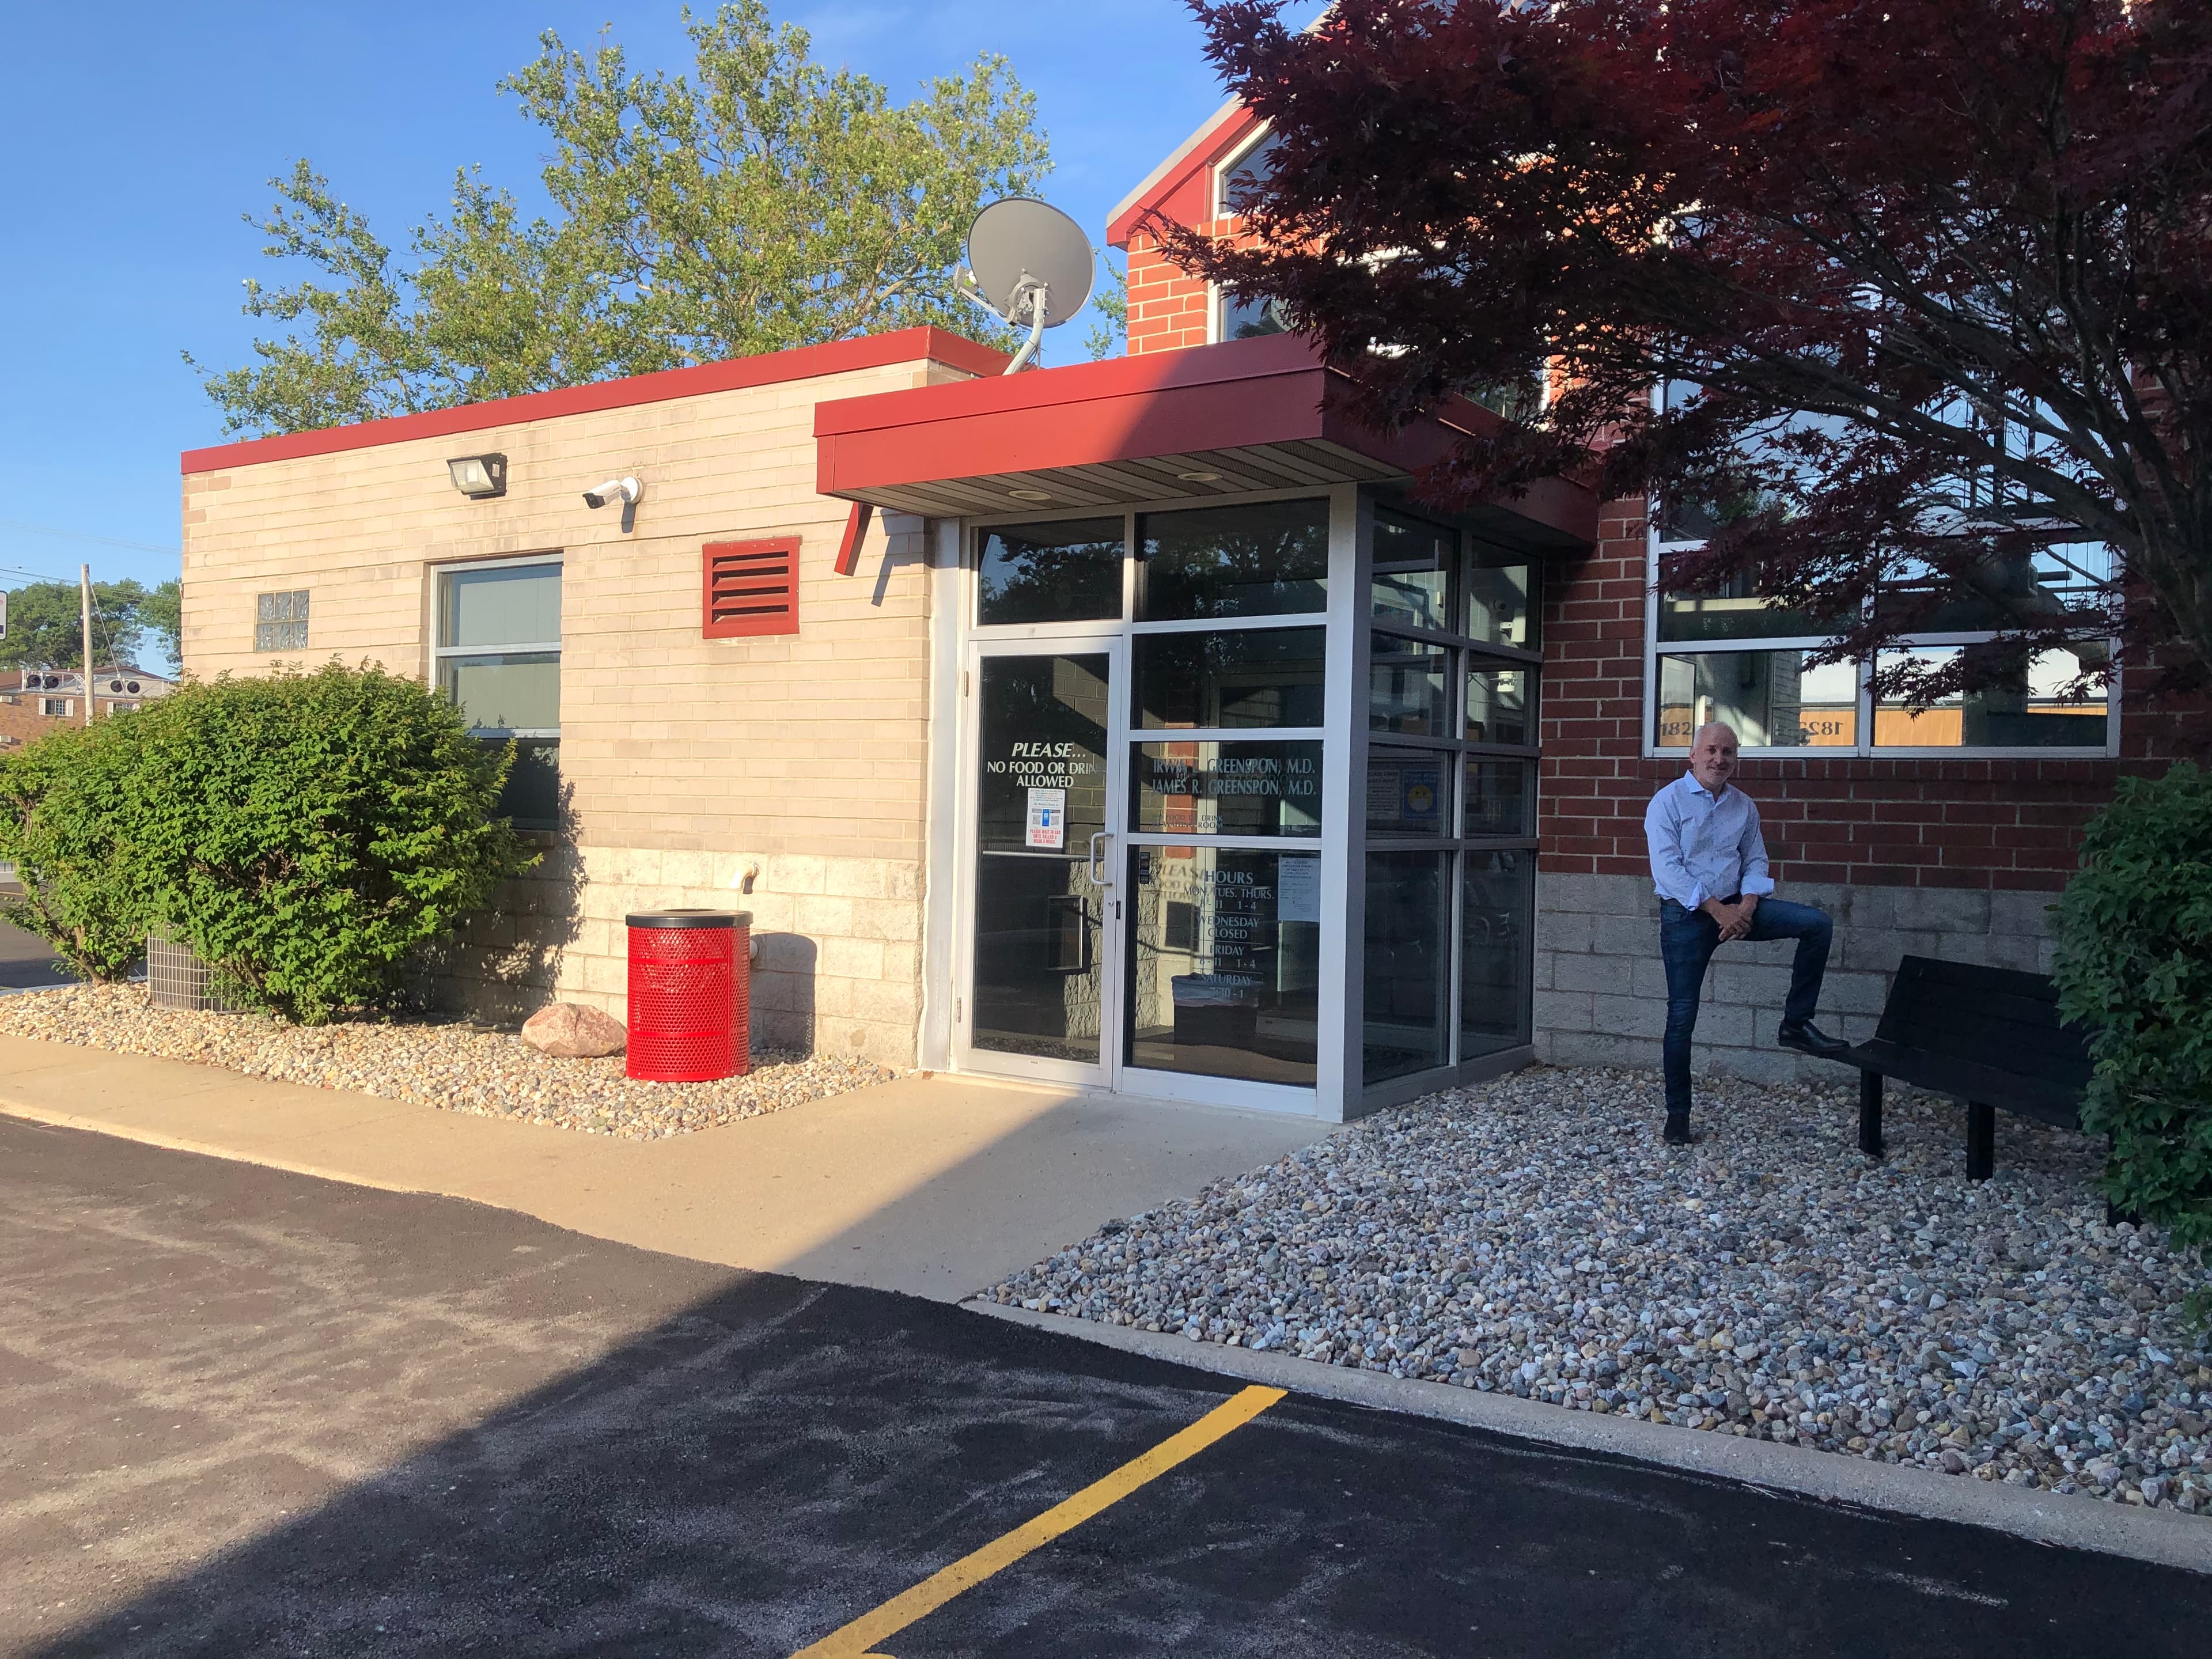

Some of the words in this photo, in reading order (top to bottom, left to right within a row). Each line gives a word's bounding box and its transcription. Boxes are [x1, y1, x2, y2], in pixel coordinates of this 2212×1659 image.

[1012, 742, 1086, 758] PLEASE...
[987, 761, 1006, 773] NO
[1009, 762, 1044, 774] FOOD
[1048, 762, 1065, 774] OR
[1069, 762, 1103, 774] DRIN
[1208, 758, 1281, 775] GREENSPON,
[1287, 758, 1315, 774] M.D.
[1016, 775, 1074, 787] ALLOWED
[1152, 779, 1187, 794] JAMES
[1192, 779, 1202, 794] R.
[1208, 779, 1282, 799] GREENSPON,
[1288, 780, 1316, 796] M.D.
[1206, 870, 1253, 884] HOURS
[1184, 886, 1209, 896] MON.
[1214, 887, 1237, 898] TUES.
[1241, 888, 1274, 899] THURS.
[1197, 915, 1260, 927] WEDNESDAY
[1208, 927, 1248, 939] CLOSED
[1210, 944, 1245, 956] FRIDAY
[1202, 974, 1252, 986] SATURDAY
